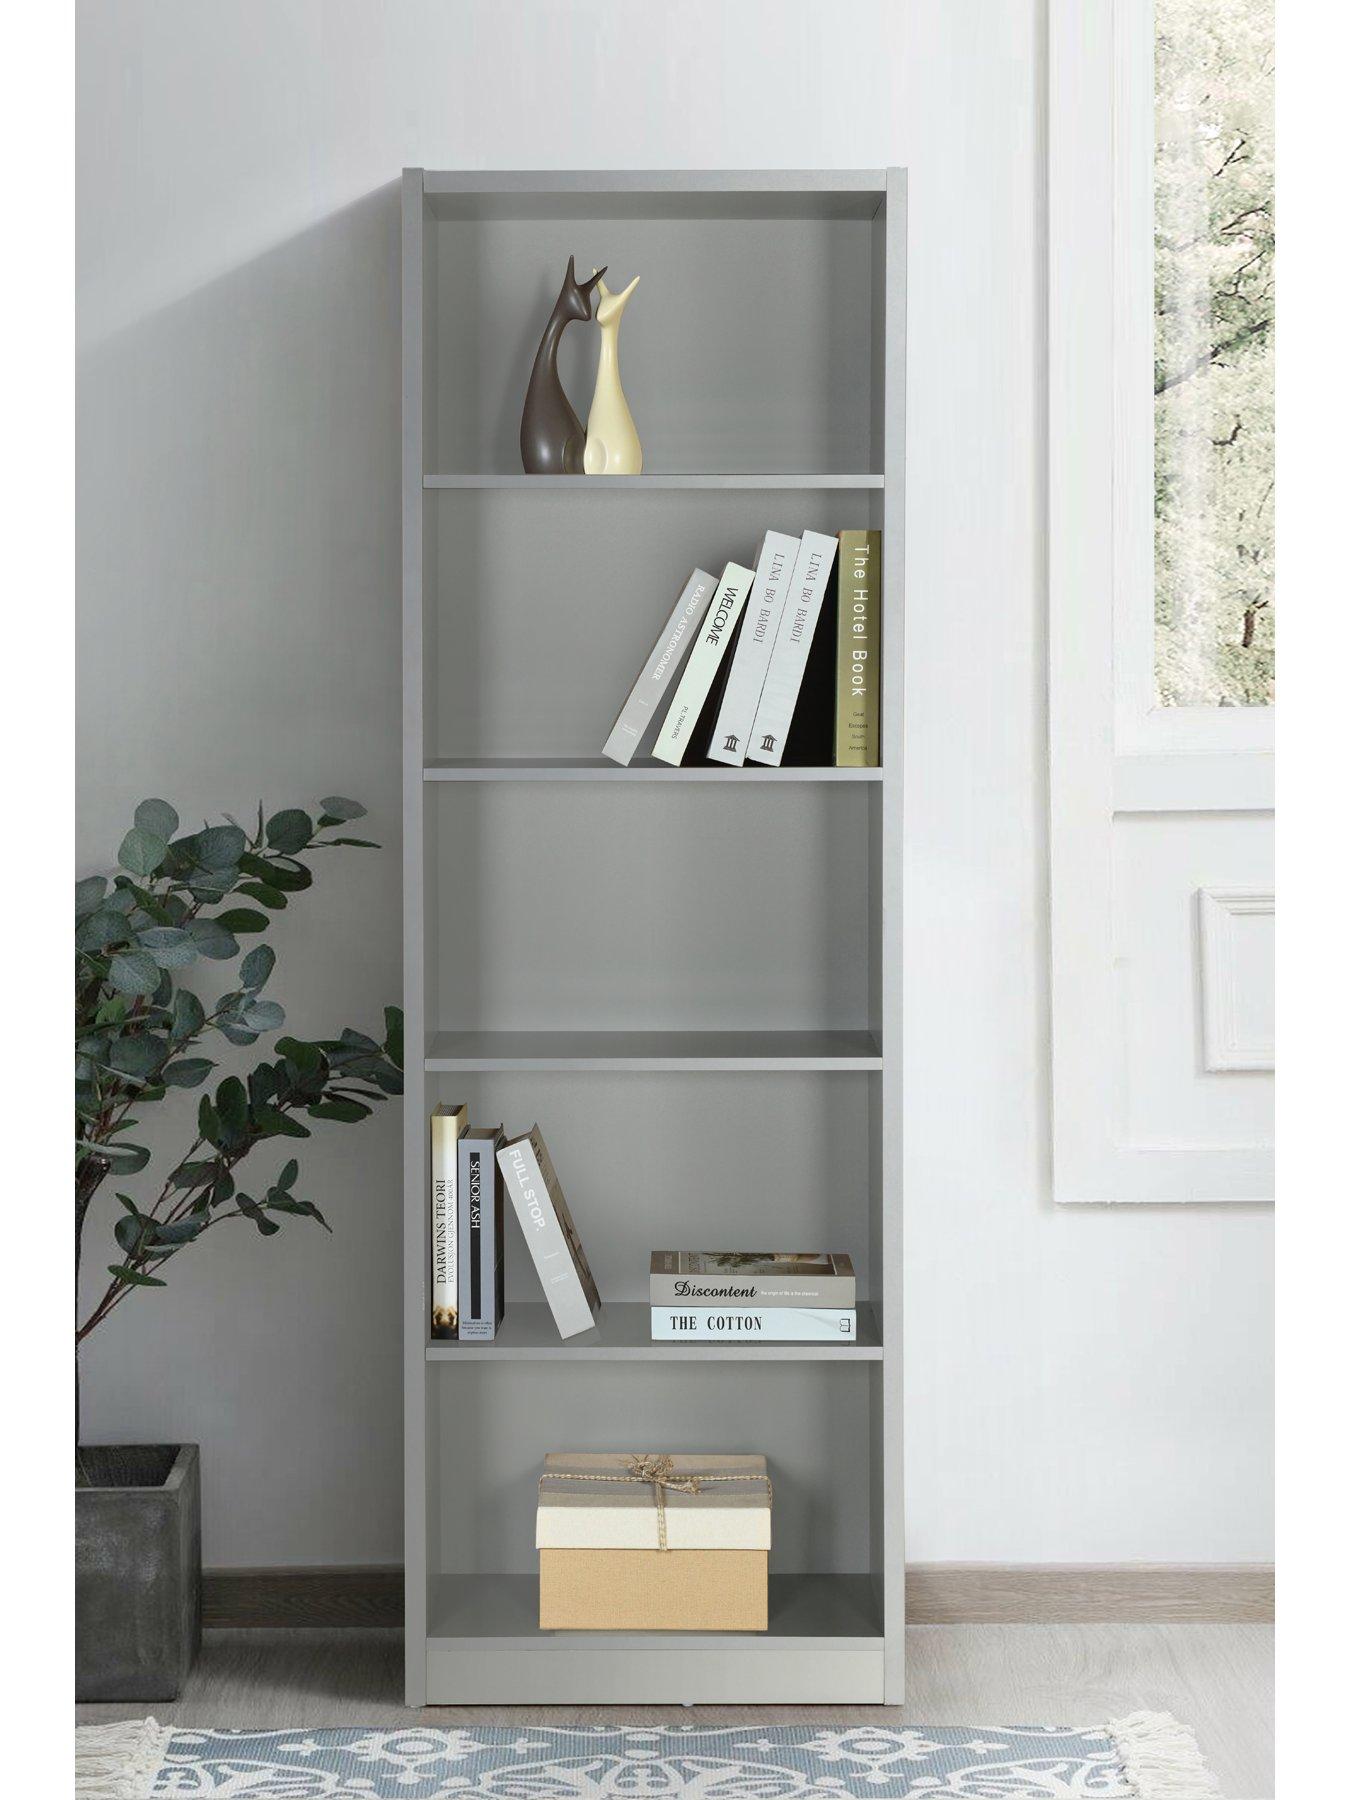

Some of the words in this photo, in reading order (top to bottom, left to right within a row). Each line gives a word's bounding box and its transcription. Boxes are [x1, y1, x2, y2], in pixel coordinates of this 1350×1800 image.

[768, 552, 785, 582] LINA
[805, 552, 822, 582] LINA
[853, 544, 870, 579] The
[685, 584, 706, 616] RADIO
[763, 588, 776, 604] BO
[800, 588, 813, 604] BO
[705, 586, 739, 647] WELCOME
[753, 608, 771, 644] BARDI
[790, 608, 808, 644] BARDI
[853, 589, 869, 640] Hotel
[651, 616, 690, 681] ASTRONOMER
[851, 650, 868, 697] Book
[435, 1179, 446, 1220] TEORI
[470, 1160, 481, 1203] SENIOR
[509, 1149, 526, 1189] FULL
[524, 1188, 547, 1232] STOP.
[471, 1205, 481, 1229] ASH
[436, 1222, 447, 1285] DARWINS
[674, 1280, 758, 1298] Discontent
[670, 1315, 697, 1331] THE
[707, 1315, 763, 1331] COTTON
